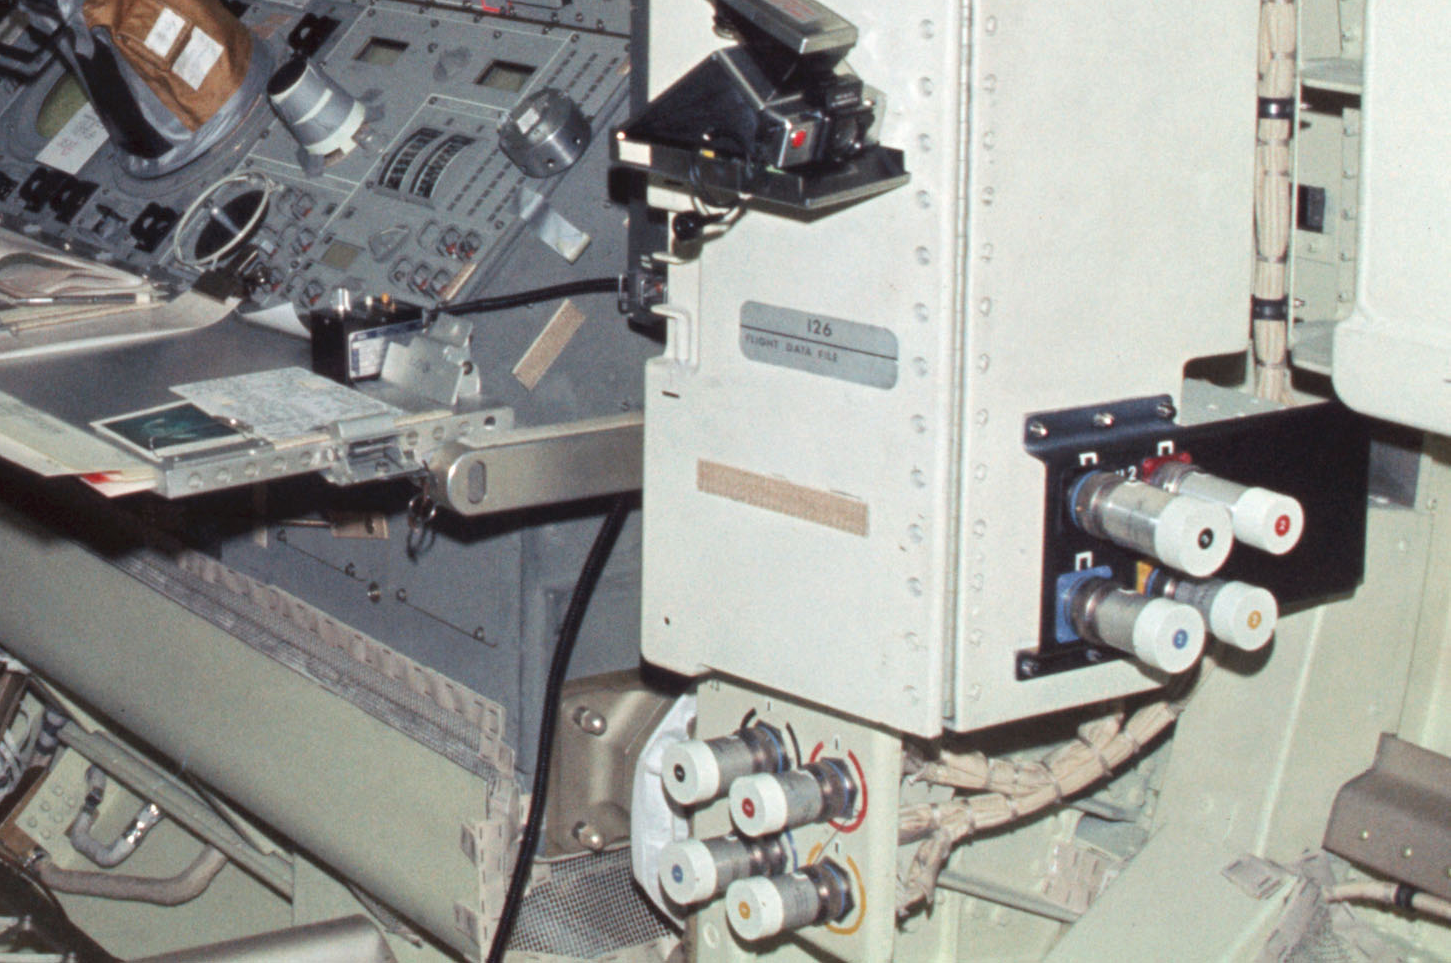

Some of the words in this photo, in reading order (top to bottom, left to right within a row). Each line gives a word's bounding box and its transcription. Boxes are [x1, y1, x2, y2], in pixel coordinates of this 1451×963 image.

[807, 318, 833, 338] 126
[745, 334, 778, 350] FLIGHT
[785, 343, 812, 357] DATA
[817, 350, 838, 364] FILE
